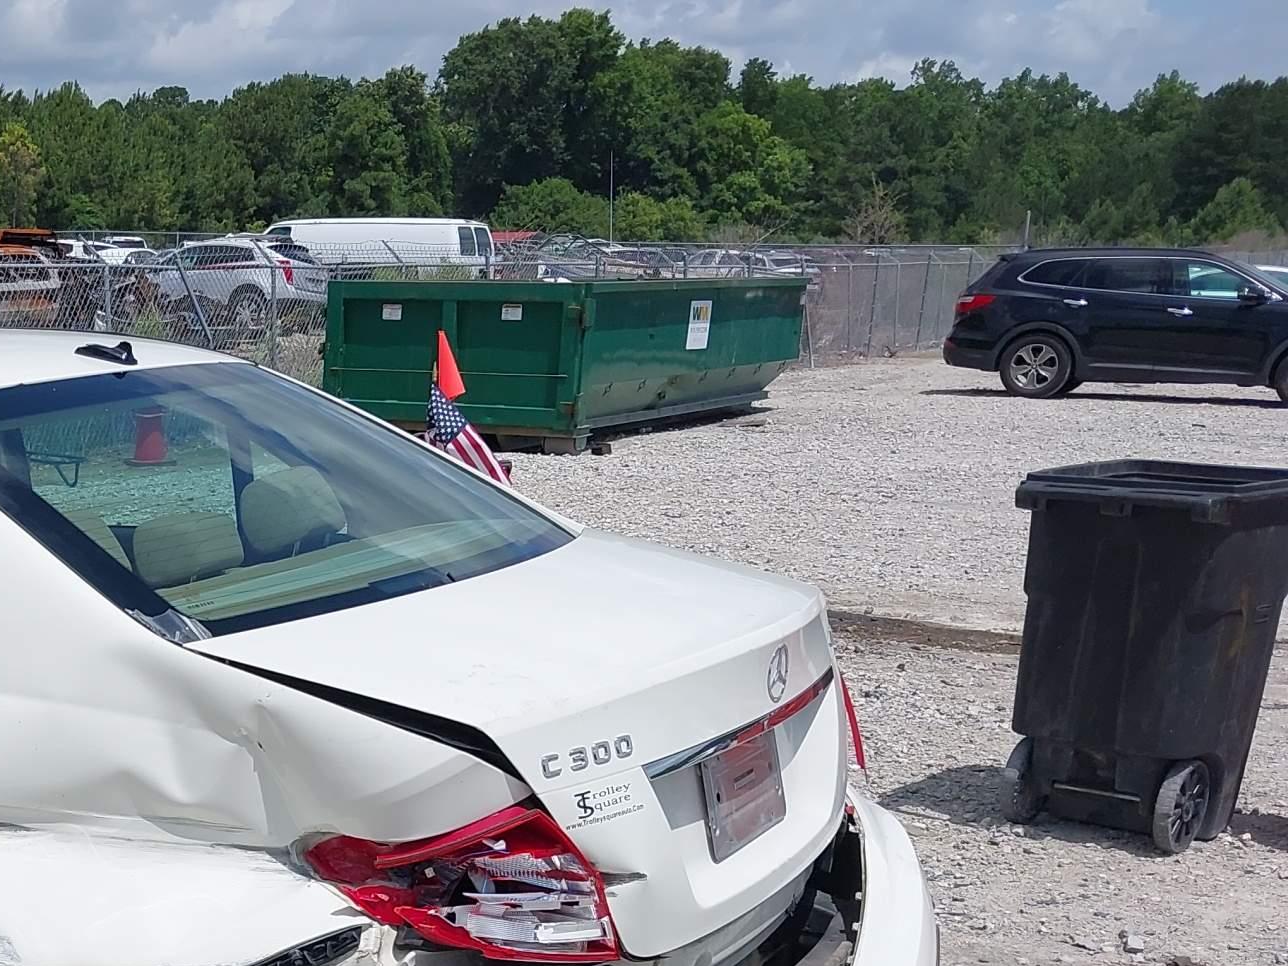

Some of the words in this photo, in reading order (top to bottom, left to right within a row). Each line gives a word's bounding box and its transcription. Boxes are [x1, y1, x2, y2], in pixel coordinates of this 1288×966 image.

[541, 754, 562, 779] C
[569, 735, 633, 772] 300
[574, 783, 631, 811] Trolley
[577, 794, 631, 819] Square
